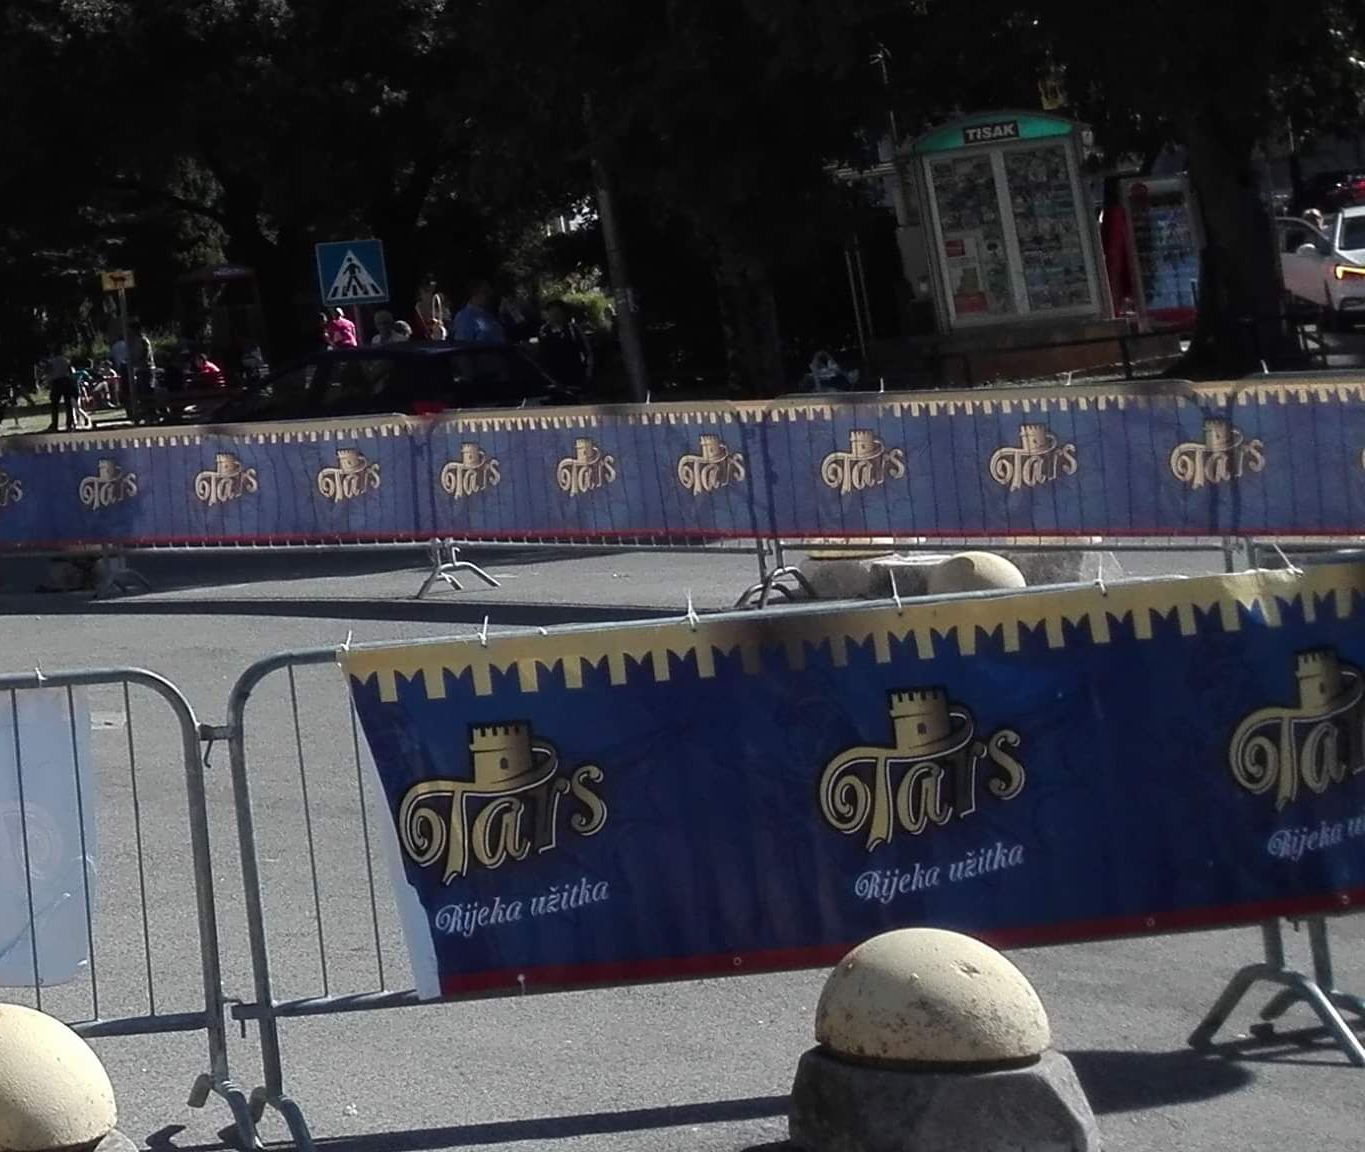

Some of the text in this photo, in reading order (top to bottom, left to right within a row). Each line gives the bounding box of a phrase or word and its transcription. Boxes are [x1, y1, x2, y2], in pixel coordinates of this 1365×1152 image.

[965, 123, 1014, 141] TISAK
[822, 445, 905, 495] Tars
[989, 440, 1078, 492] Tars
[820, 713, 1025, 852] Tars
[399, 748, 607, 886] Tars
[854, 841, 1024, 904] Rijeka užitka
[435, 876, 610, 937] Rijeka užitka
